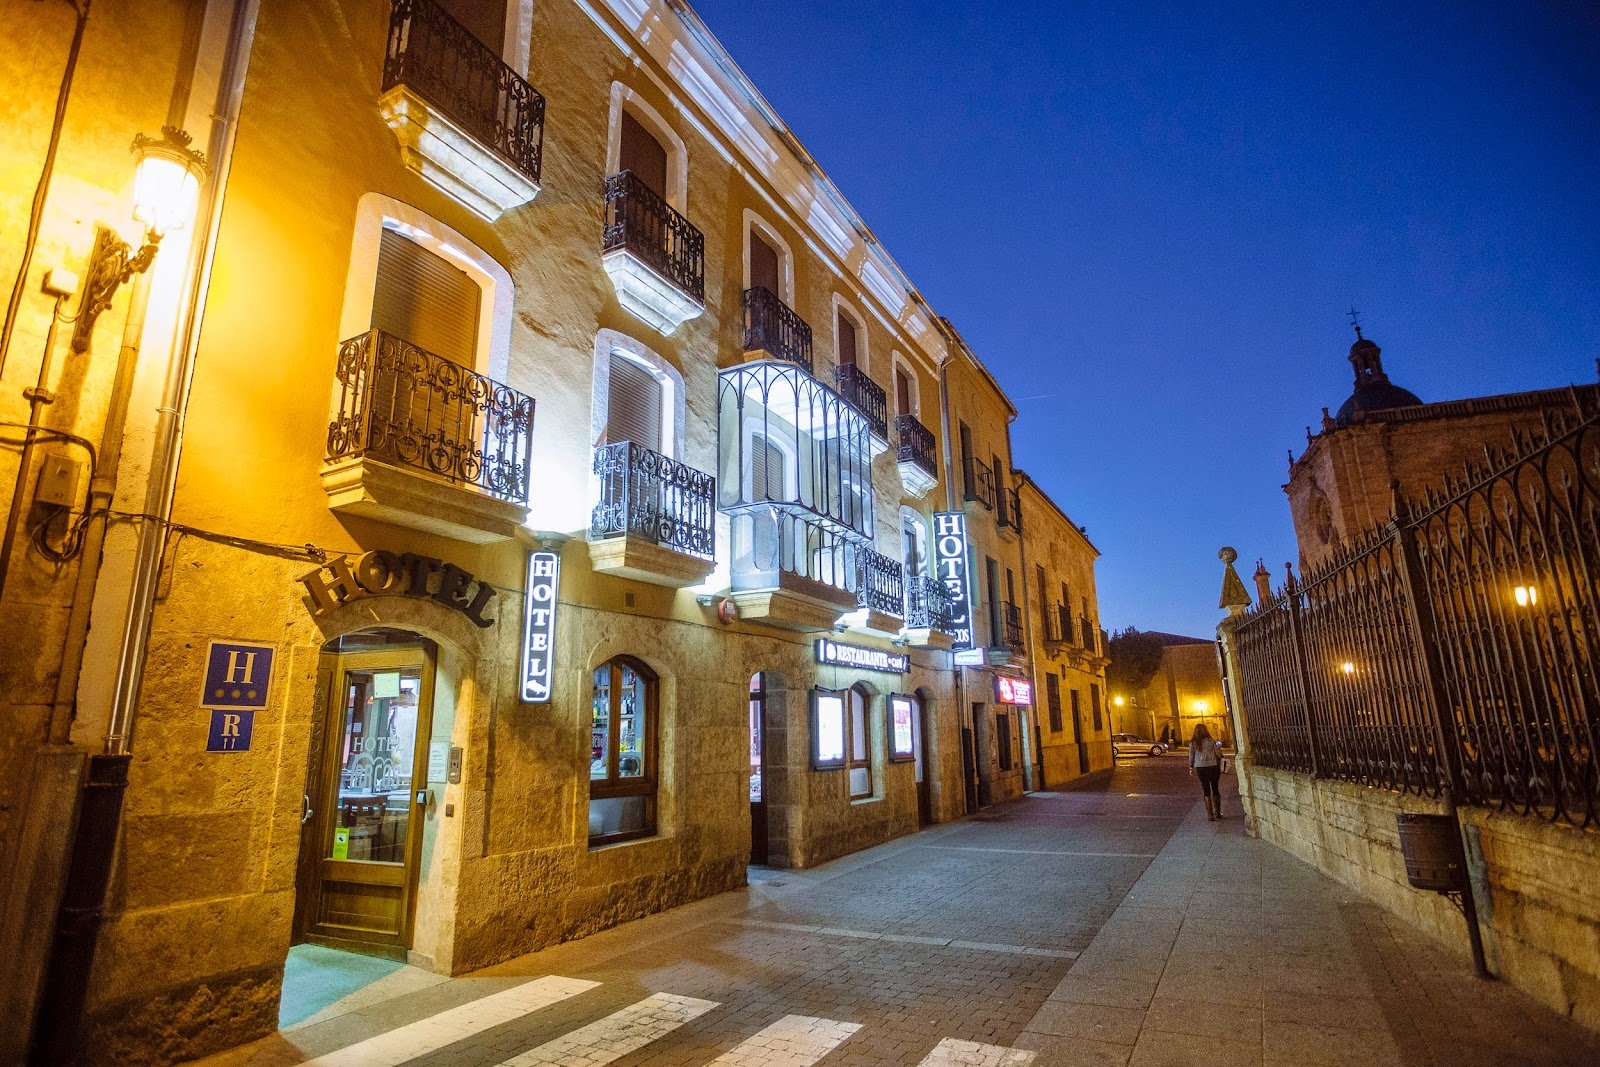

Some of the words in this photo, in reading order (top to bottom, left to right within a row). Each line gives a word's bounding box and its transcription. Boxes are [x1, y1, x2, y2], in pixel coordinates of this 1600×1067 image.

[295, 551, 497, 629] HOTEL
[530, 560, 554, 677] HOTEL
[223, 650, 257, 684] H
[836, 645, 888, 667] RESTAURANTE
[221, 714, 240, 736] R
